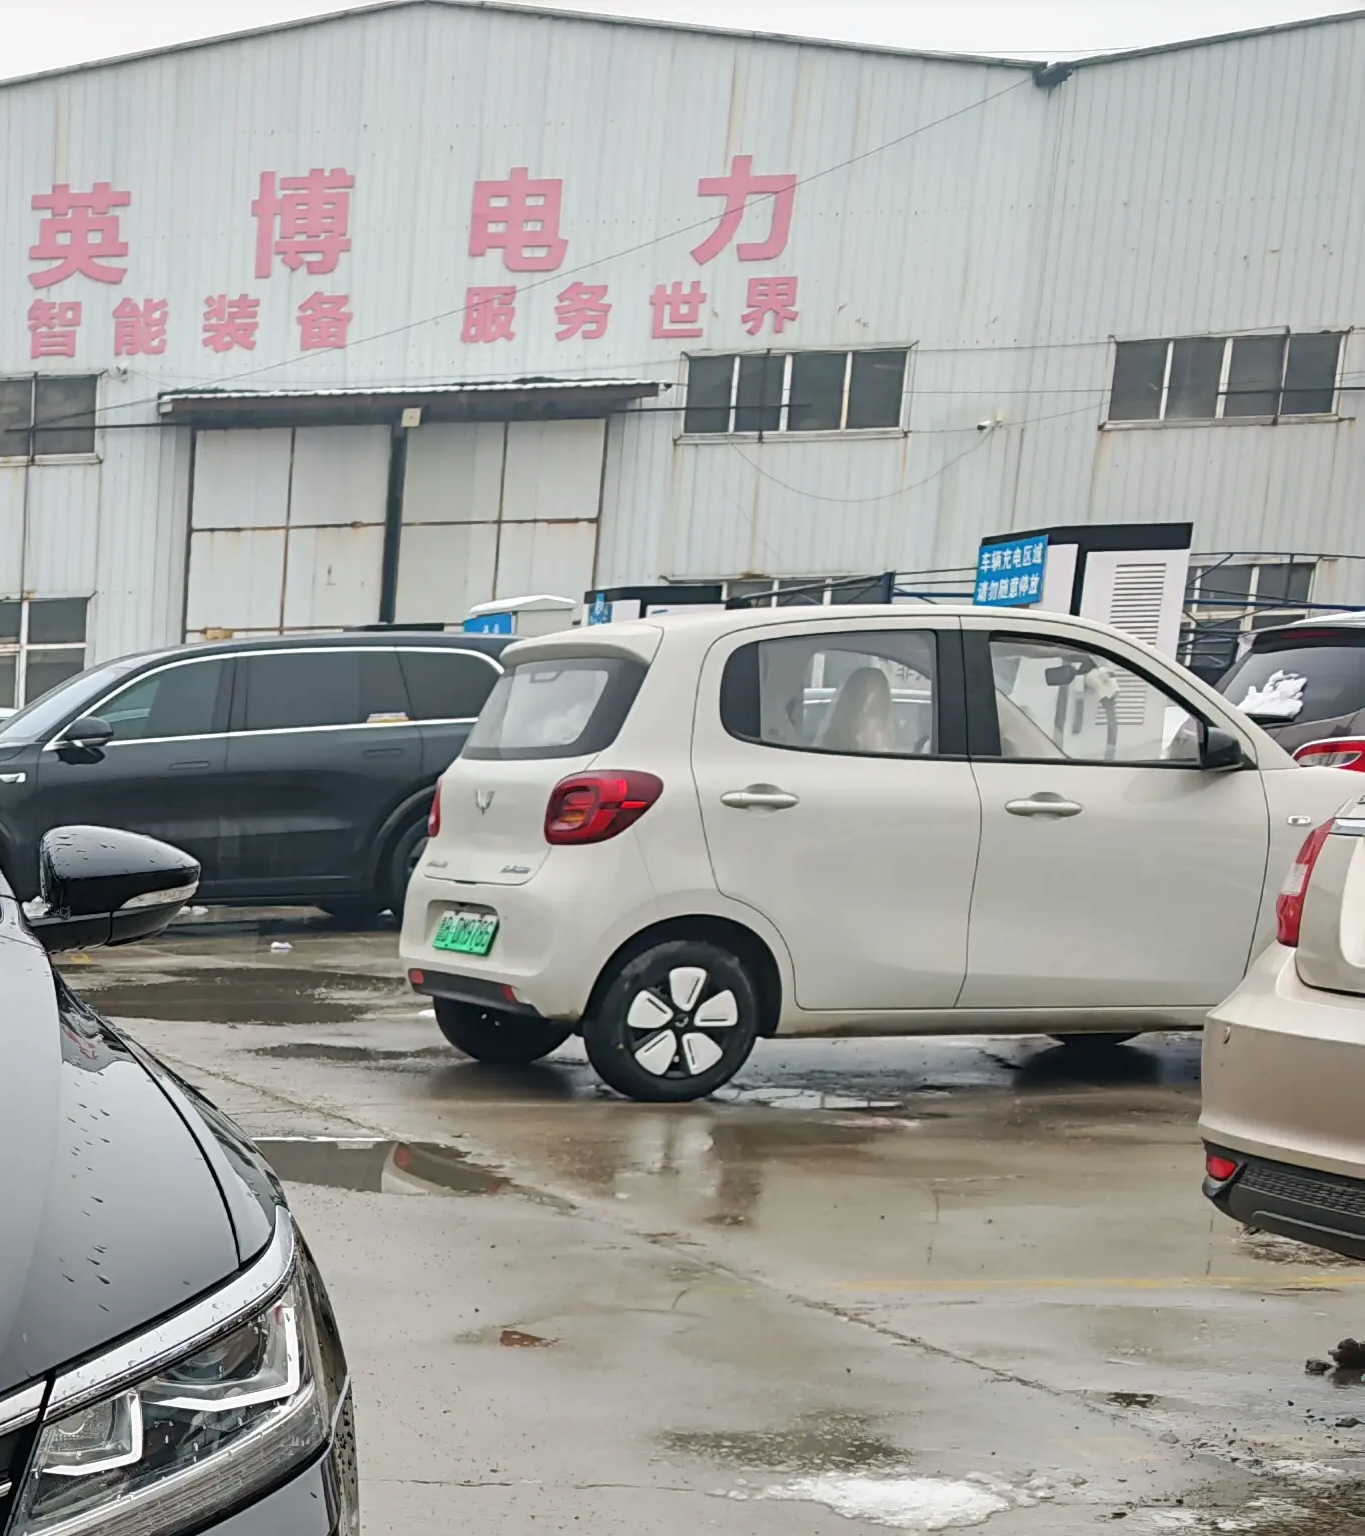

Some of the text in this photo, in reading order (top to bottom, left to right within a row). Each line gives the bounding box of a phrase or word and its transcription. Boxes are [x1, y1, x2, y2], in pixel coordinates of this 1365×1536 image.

[27, 155, 797, 290] 英博电力
[27, 276, 799, 359] 智能装备 服务世界
[980, 542, 1043, 573] 车辆充电区域
